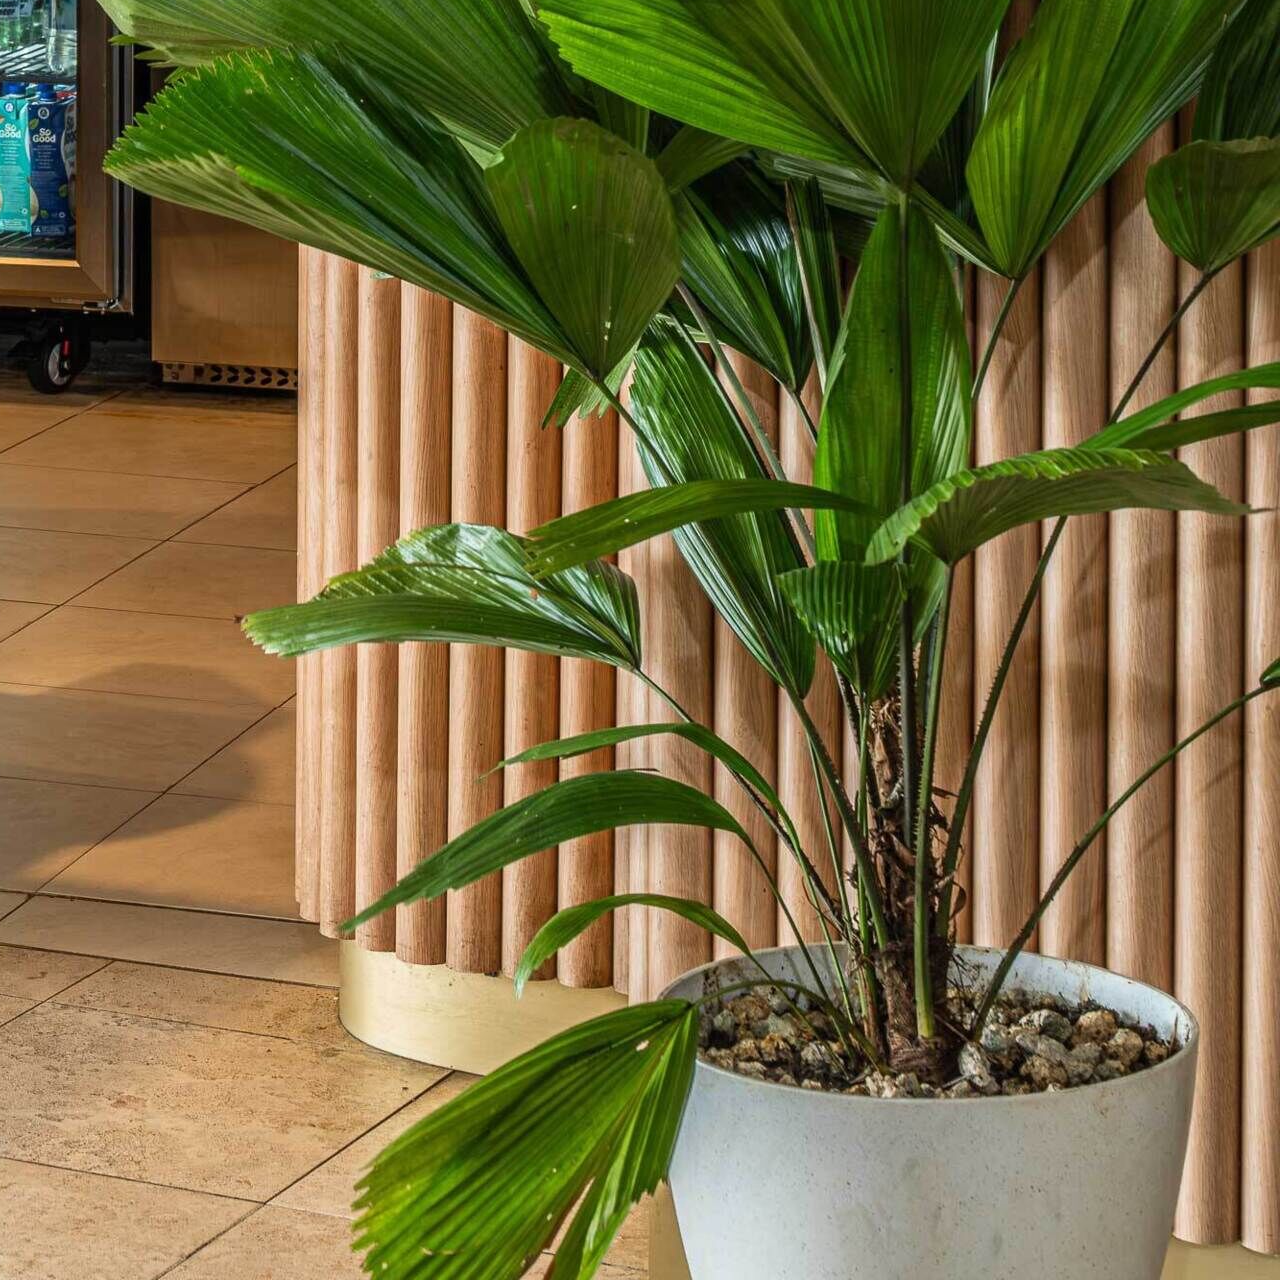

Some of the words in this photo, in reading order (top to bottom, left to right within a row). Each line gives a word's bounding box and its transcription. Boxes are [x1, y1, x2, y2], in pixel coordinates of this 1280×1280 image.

[3, 123, 17, 132] So
[39, 127, 52, 136] So
[31, 134, 57, 143] Good
